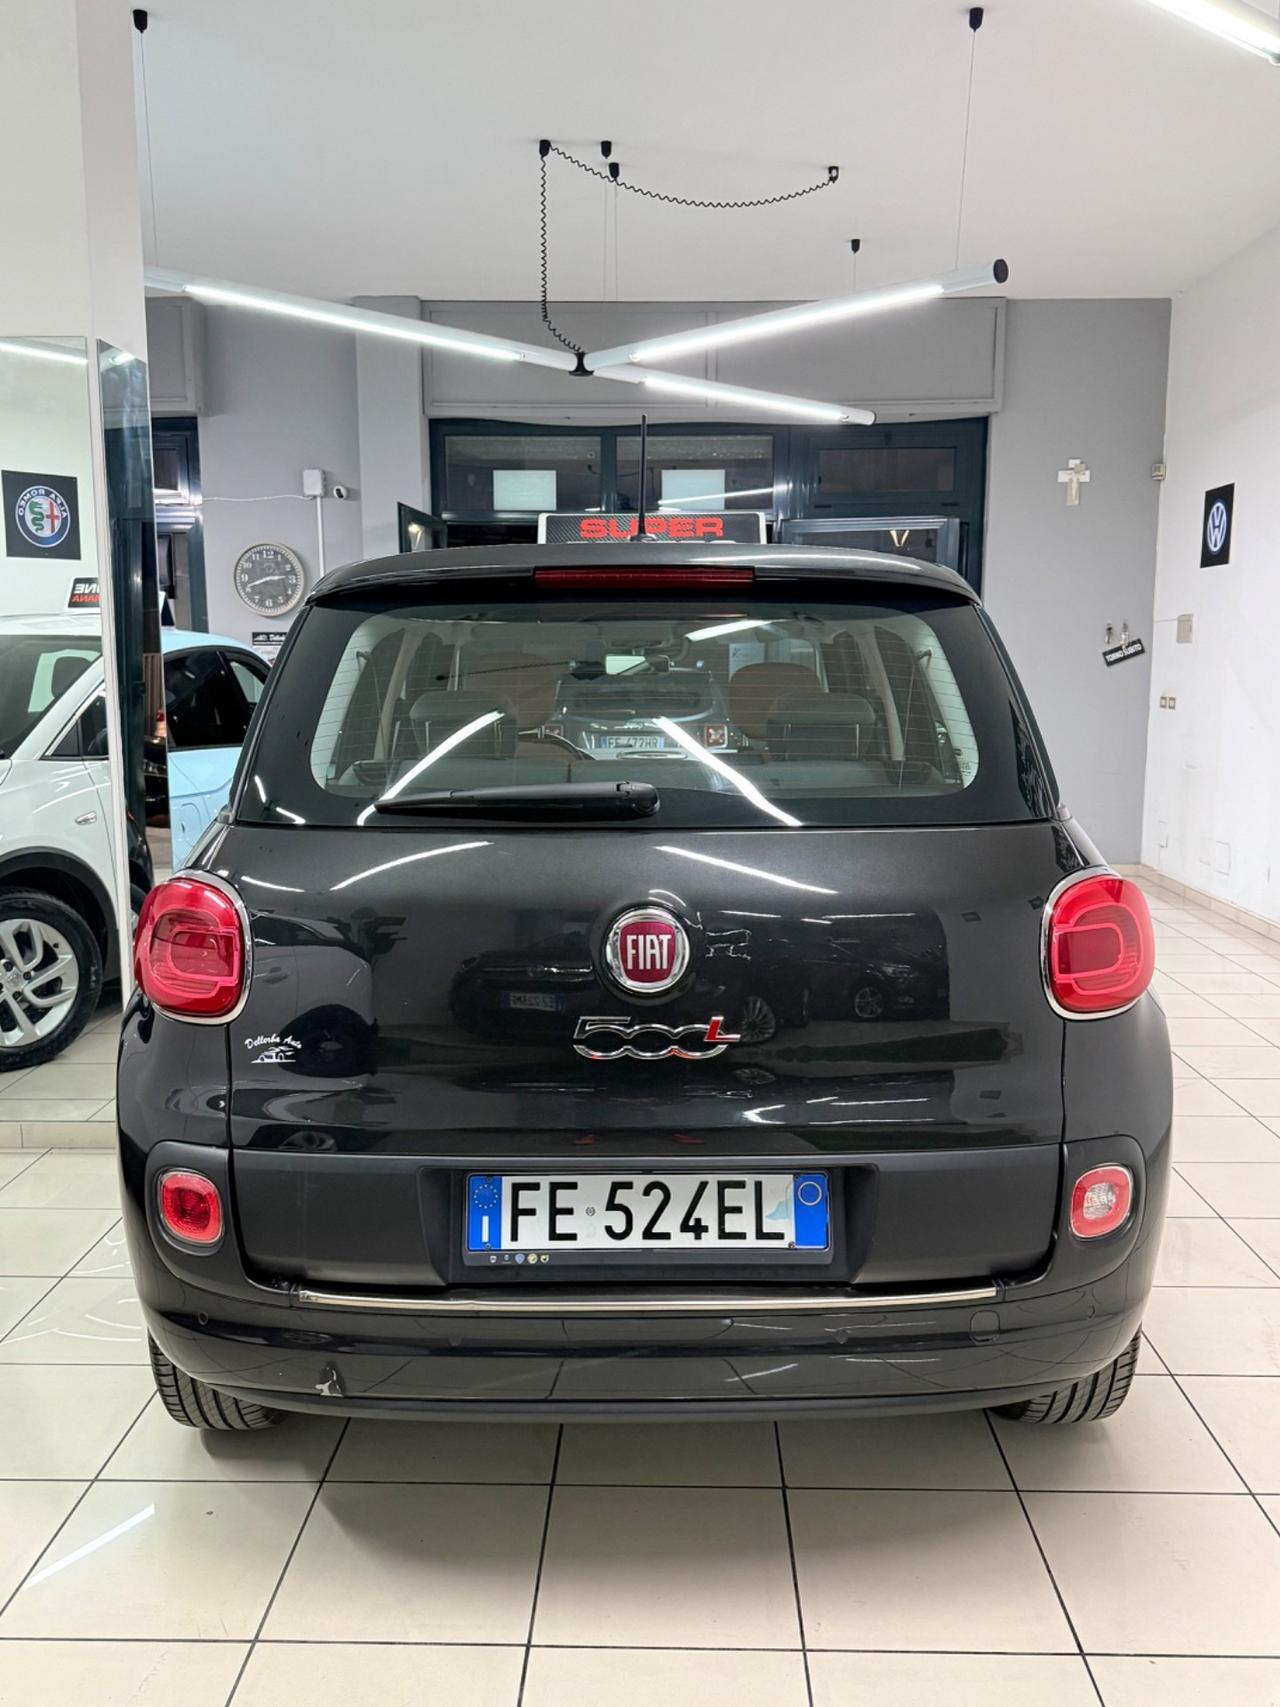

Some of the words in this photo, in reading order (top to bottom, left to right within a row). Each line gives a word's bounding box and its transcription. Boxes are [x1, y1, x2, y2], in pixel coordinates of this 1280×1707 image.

[580, 517, 724, 538] SUPER
[252, 553, 260, 561] 11
[262, 550, 275, 559] 12
[288, 575, 297, 584] 3
[626, 934, 672, 970] FIAT
[573, 1015, 741, 1060] 500L
[510, 1180, 578, 1242] FE
[604, 1179, 786, 1242] 524EL
